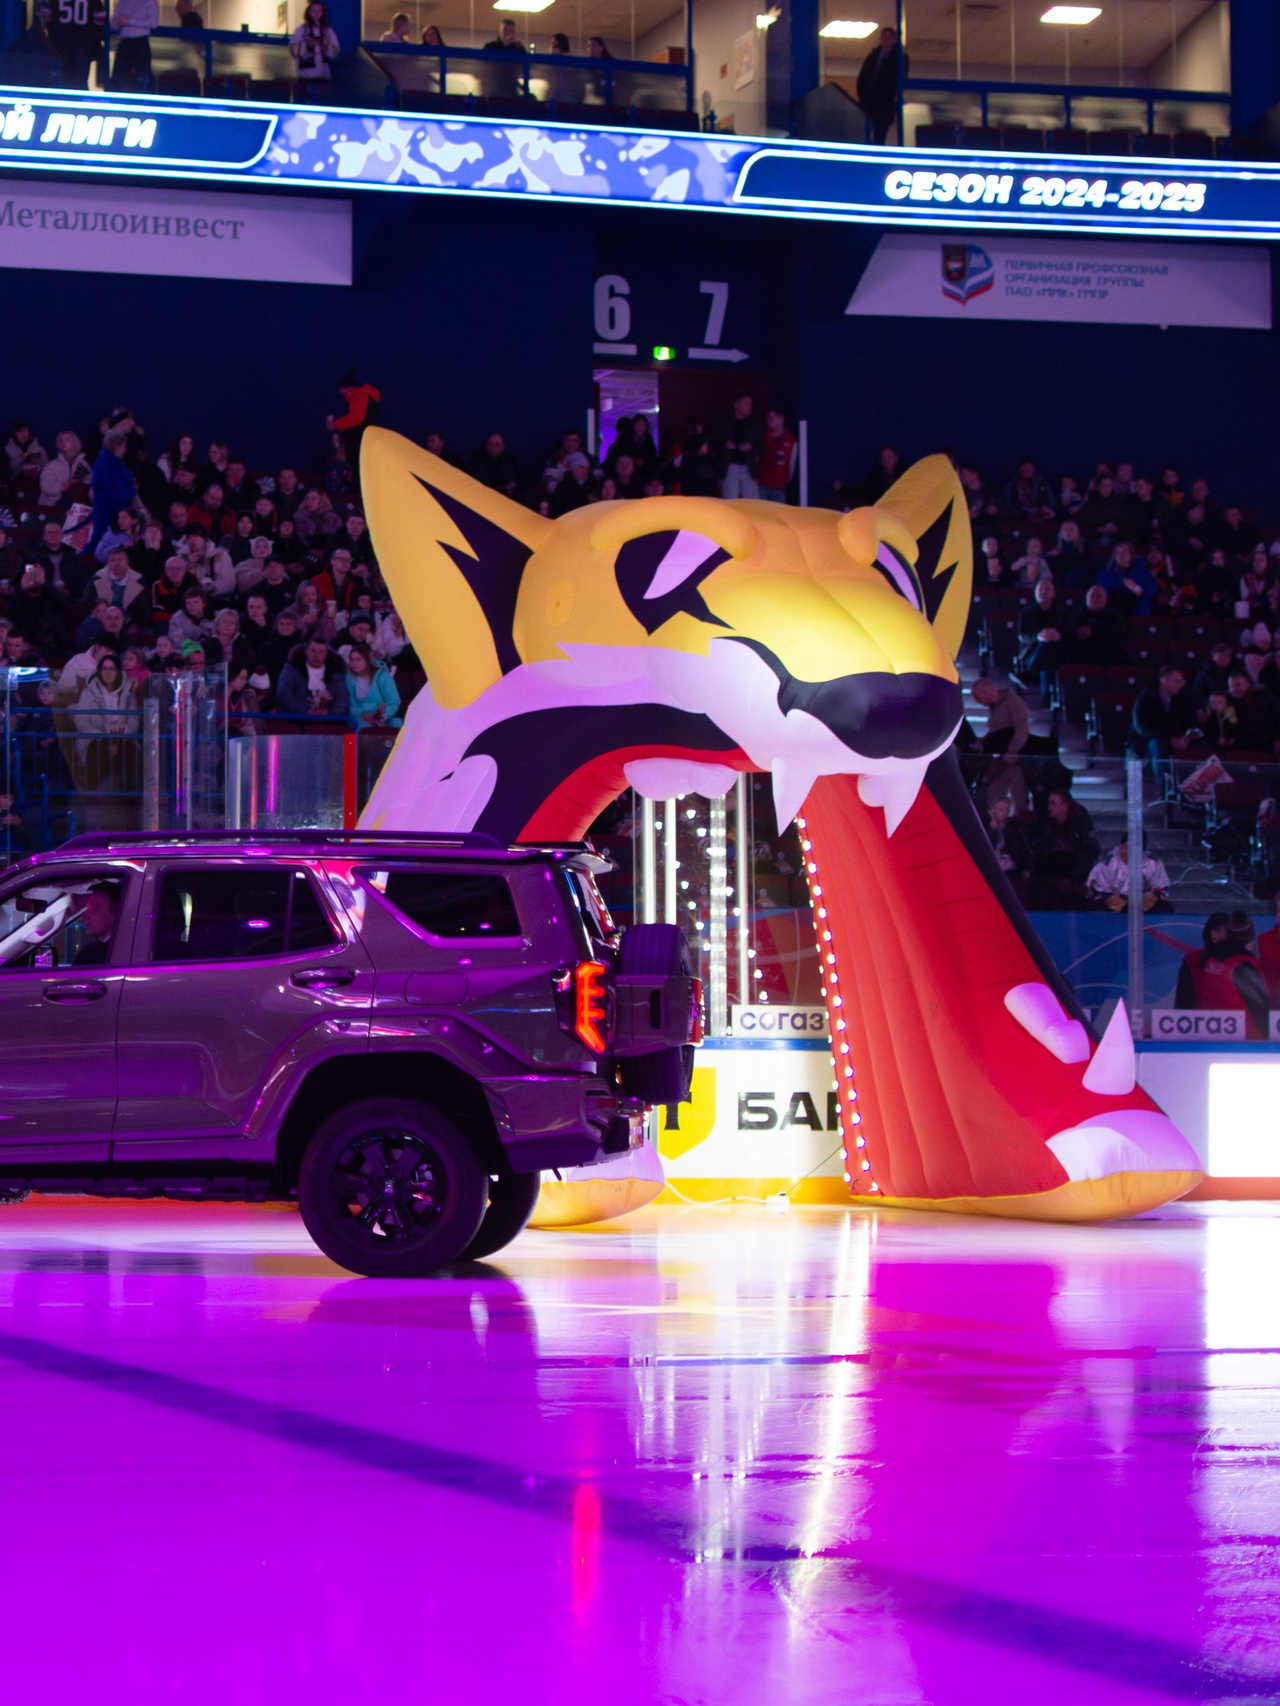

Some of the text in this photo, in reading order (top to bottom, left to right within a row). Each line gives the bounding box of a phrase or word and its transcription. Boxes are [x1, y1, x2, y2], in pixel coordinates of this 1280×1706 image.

[58, 0, 89, 26] 50
[40, 112, 157, 148] ЛИГИ
[884, 168, 1208, 213] СЕЗОН 2024-2025
[1005, 259, 1169, 275] ПЕРВИЧНАЯ ПРОФСОЮЗНАЯ
[1005, 273, 1091, 286] ОРГАНИЗАЦИЯ
[593, 273, 729, 346] 6 7
[740, 1011, 825, 1031] согаз
[1159, 1016, 1238, 1034] согаз
